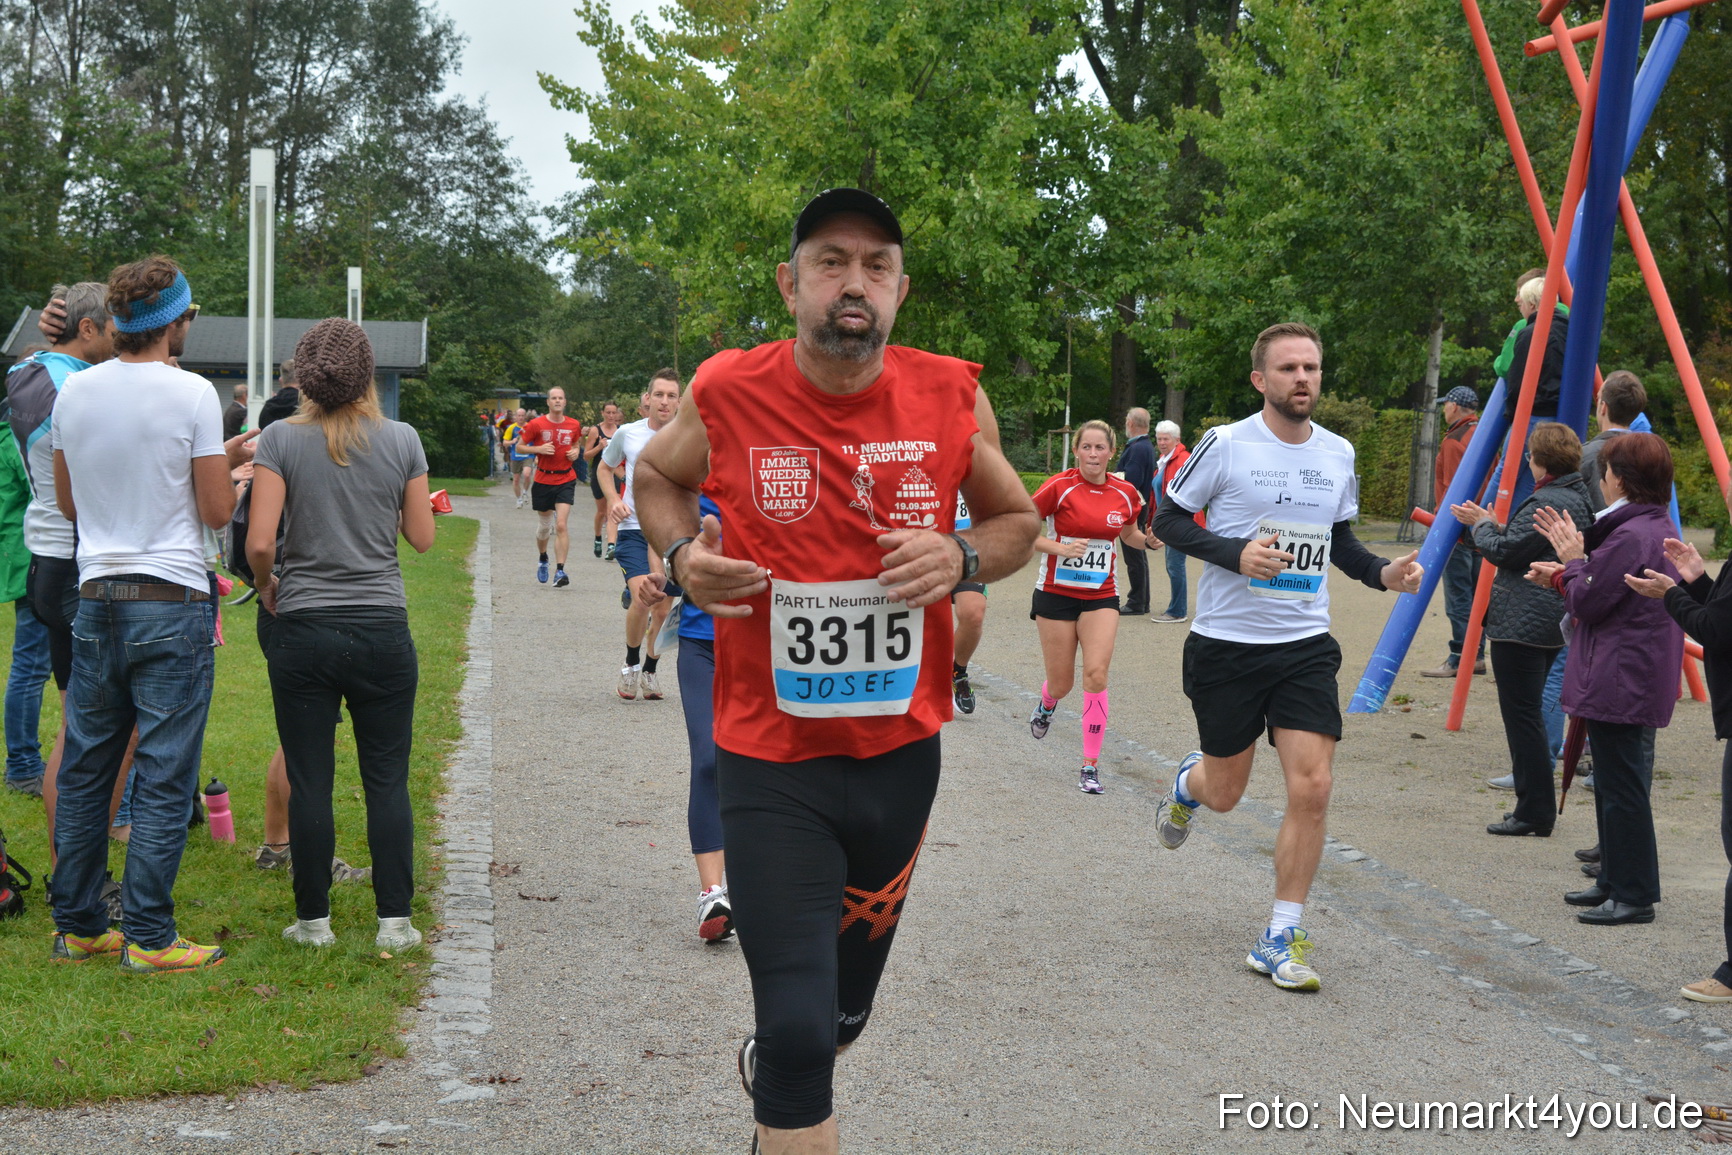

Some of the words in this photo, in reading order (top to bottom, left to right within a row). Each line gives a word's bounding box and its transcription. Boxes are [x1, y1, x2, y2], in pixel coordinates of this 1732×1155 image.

[841, 444, 859, 455] 11.
[860, 440, 938, 455] NEUMARKTER
[760, 456, 808, 469] IMMER
[859, 451, 925, 464] STADTLAUF
[758, 469, 812, 480] WIEDER
[1250, 470, 1290, 479] PEUGEOT
[1299, 469, 1322, 478] HECK
[1254, 478, 1288, 488] MÜLLER
[1302, 477, 1334, 487] DESIGN
[762, 481, 808, 498] NEU
[763, 499, 808, 510] MARKT
[894, 500, 941, 510] 19.09.2010
[1259, 526, 1287, 537] PARTL
[1288, 530, 1324, 540] Neumarkt
[1267, 540, 1326, 571] 404
[1073, 572, 1091, 581] Julia
[1269, 576, 1312, 590] Dominik
[774, 593, 825, 609] PARTL
[829, 595, 901, 608] Neumar
[787, 611, 911, 665] 3315
[796, 670, 896, 699] JOSEF
